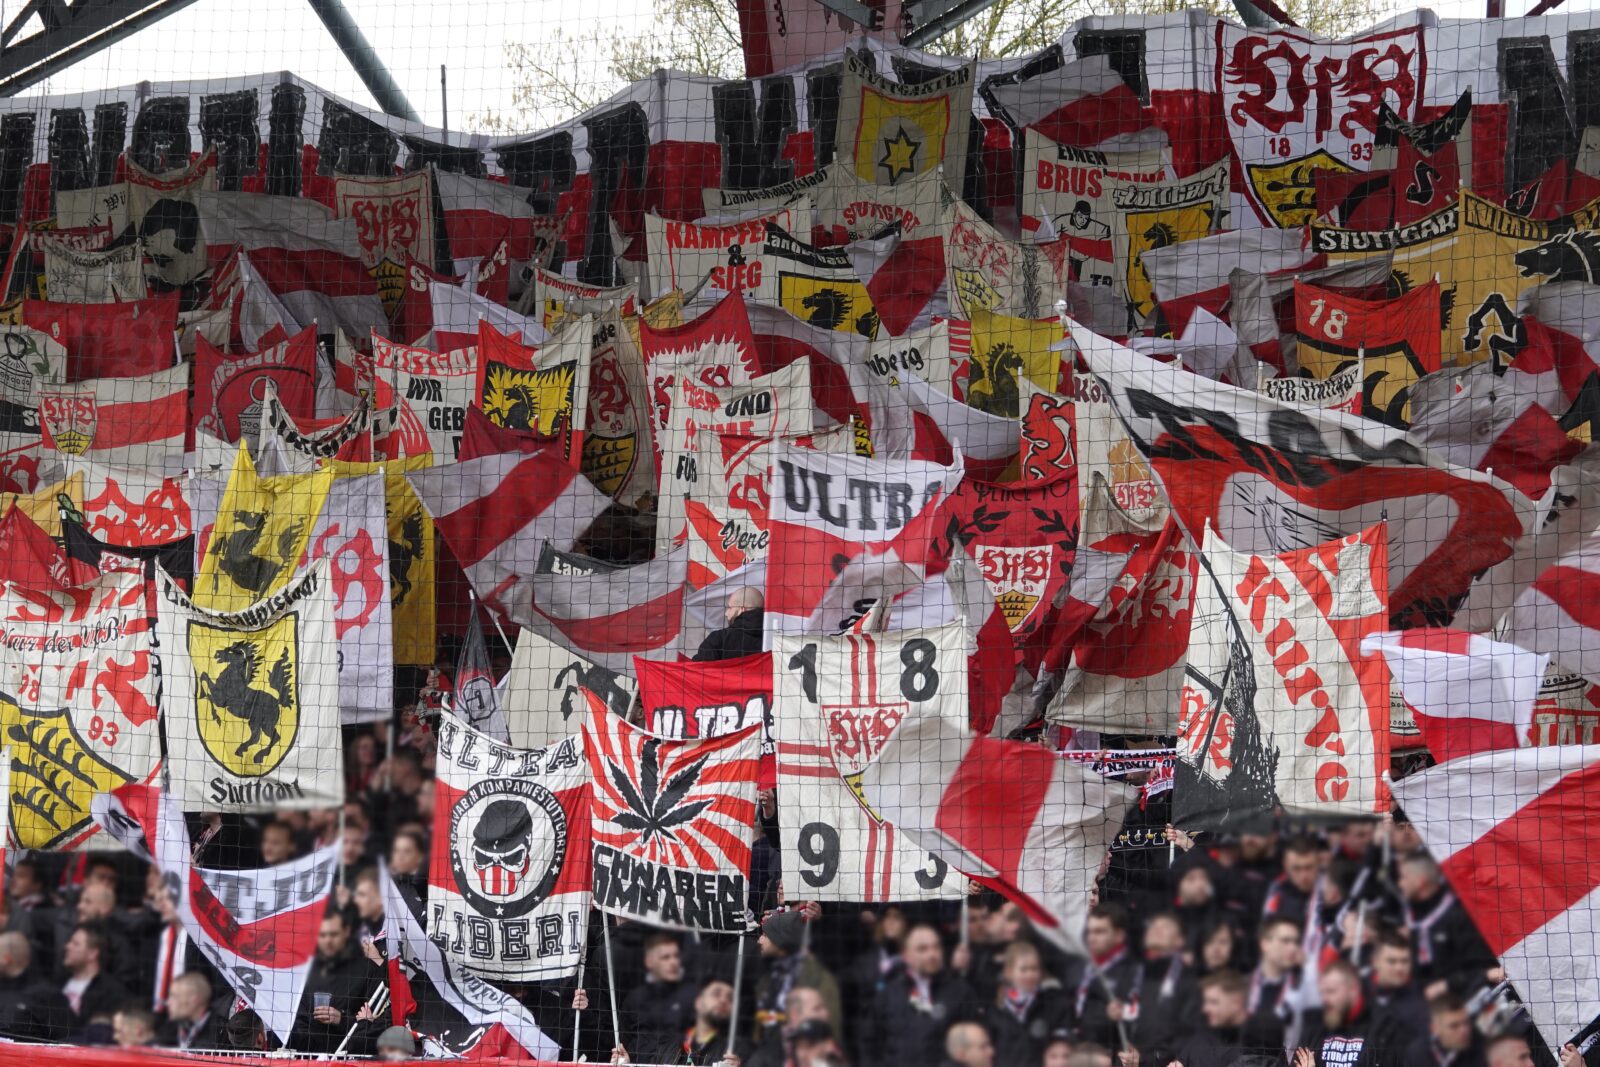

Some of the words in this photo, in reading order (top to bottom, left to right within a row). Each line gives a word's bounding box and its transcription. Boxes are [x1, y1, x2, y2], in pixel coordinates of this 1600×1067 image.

[1268, 136, 1291, 157] 18
[1350, 142, 1374, 161] 93
[728, 243, 747, 267] &
[711, 260, 762, 291] SIEG
[405, 376, 443, 403] WIR
[724, 391, 771, 418] UND
[87, 714, 120, 747] 93
[430, 904, 582, 962] LIBERI
